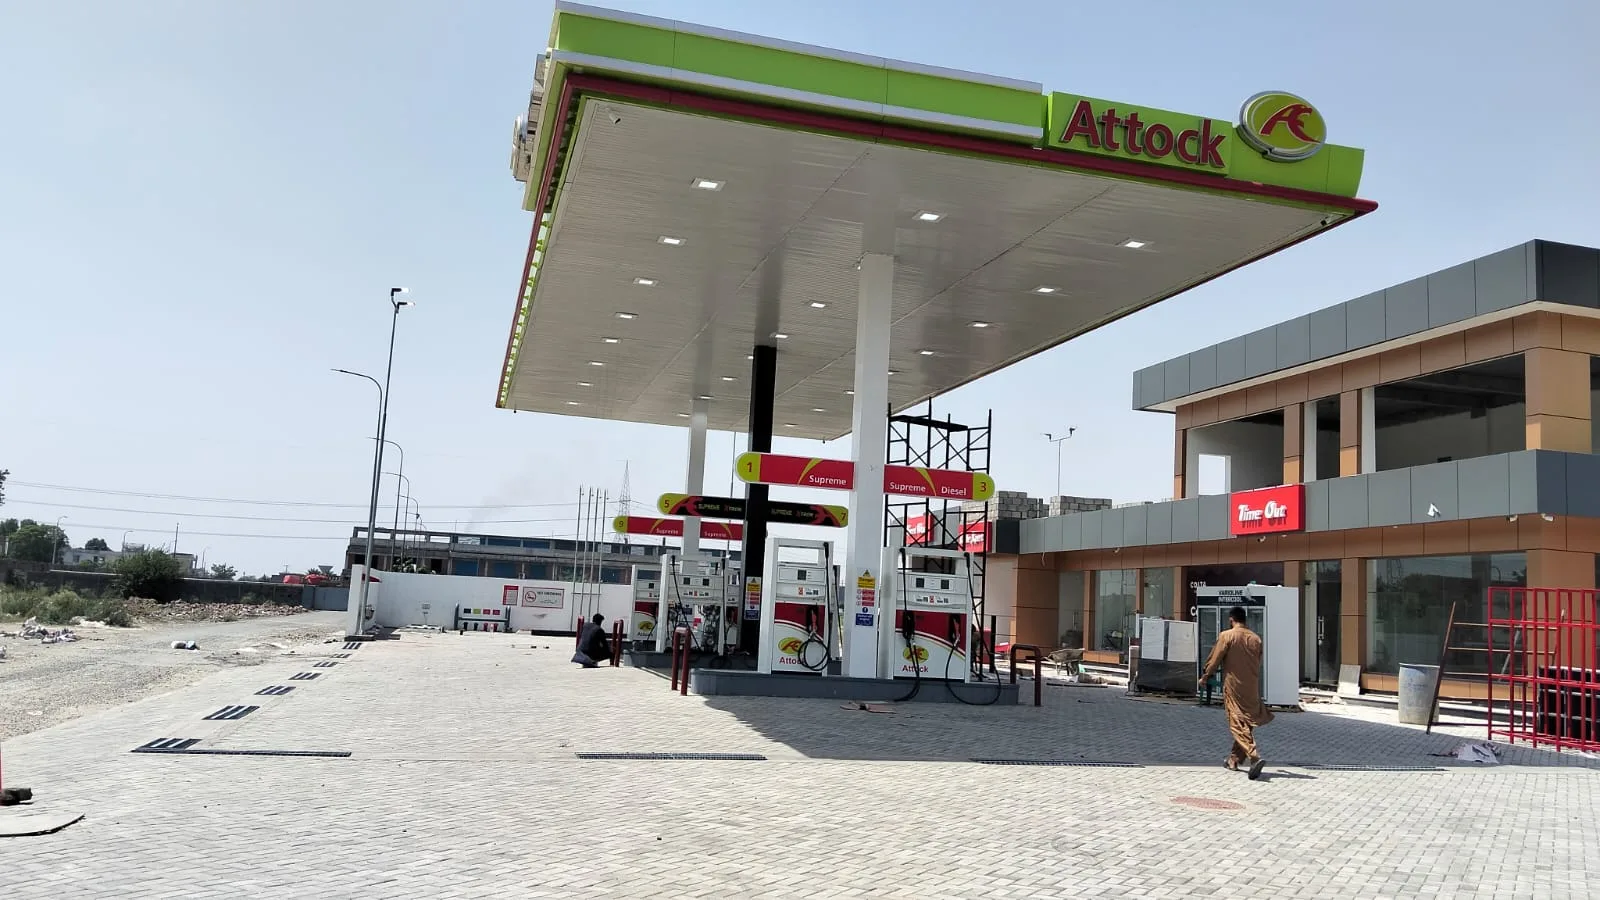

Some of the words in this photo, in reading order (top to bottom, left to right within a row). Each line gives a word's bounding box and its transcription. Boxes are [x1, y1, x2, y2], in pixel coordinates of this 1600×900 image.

[1061, 99, 1226, 167] Attock
[746, 462, 753, 473] 1
[809, 474, 847, 486] Supreme
[889, 481, 926, 493] Supreme
[941, 486, 967, 496] Diesel
[979, 481, 987, 492] 3
[664, 500, 670, 508] 5
[1238, 504, 1263, 521] Time
[1264, 500, 1287, 519] Out
[841, 512, 847, 521] 7
[618, 520, 624, 528] 9
[779, 656, 804, 665] Attoc
[902, 664, 929, 673] Attck
